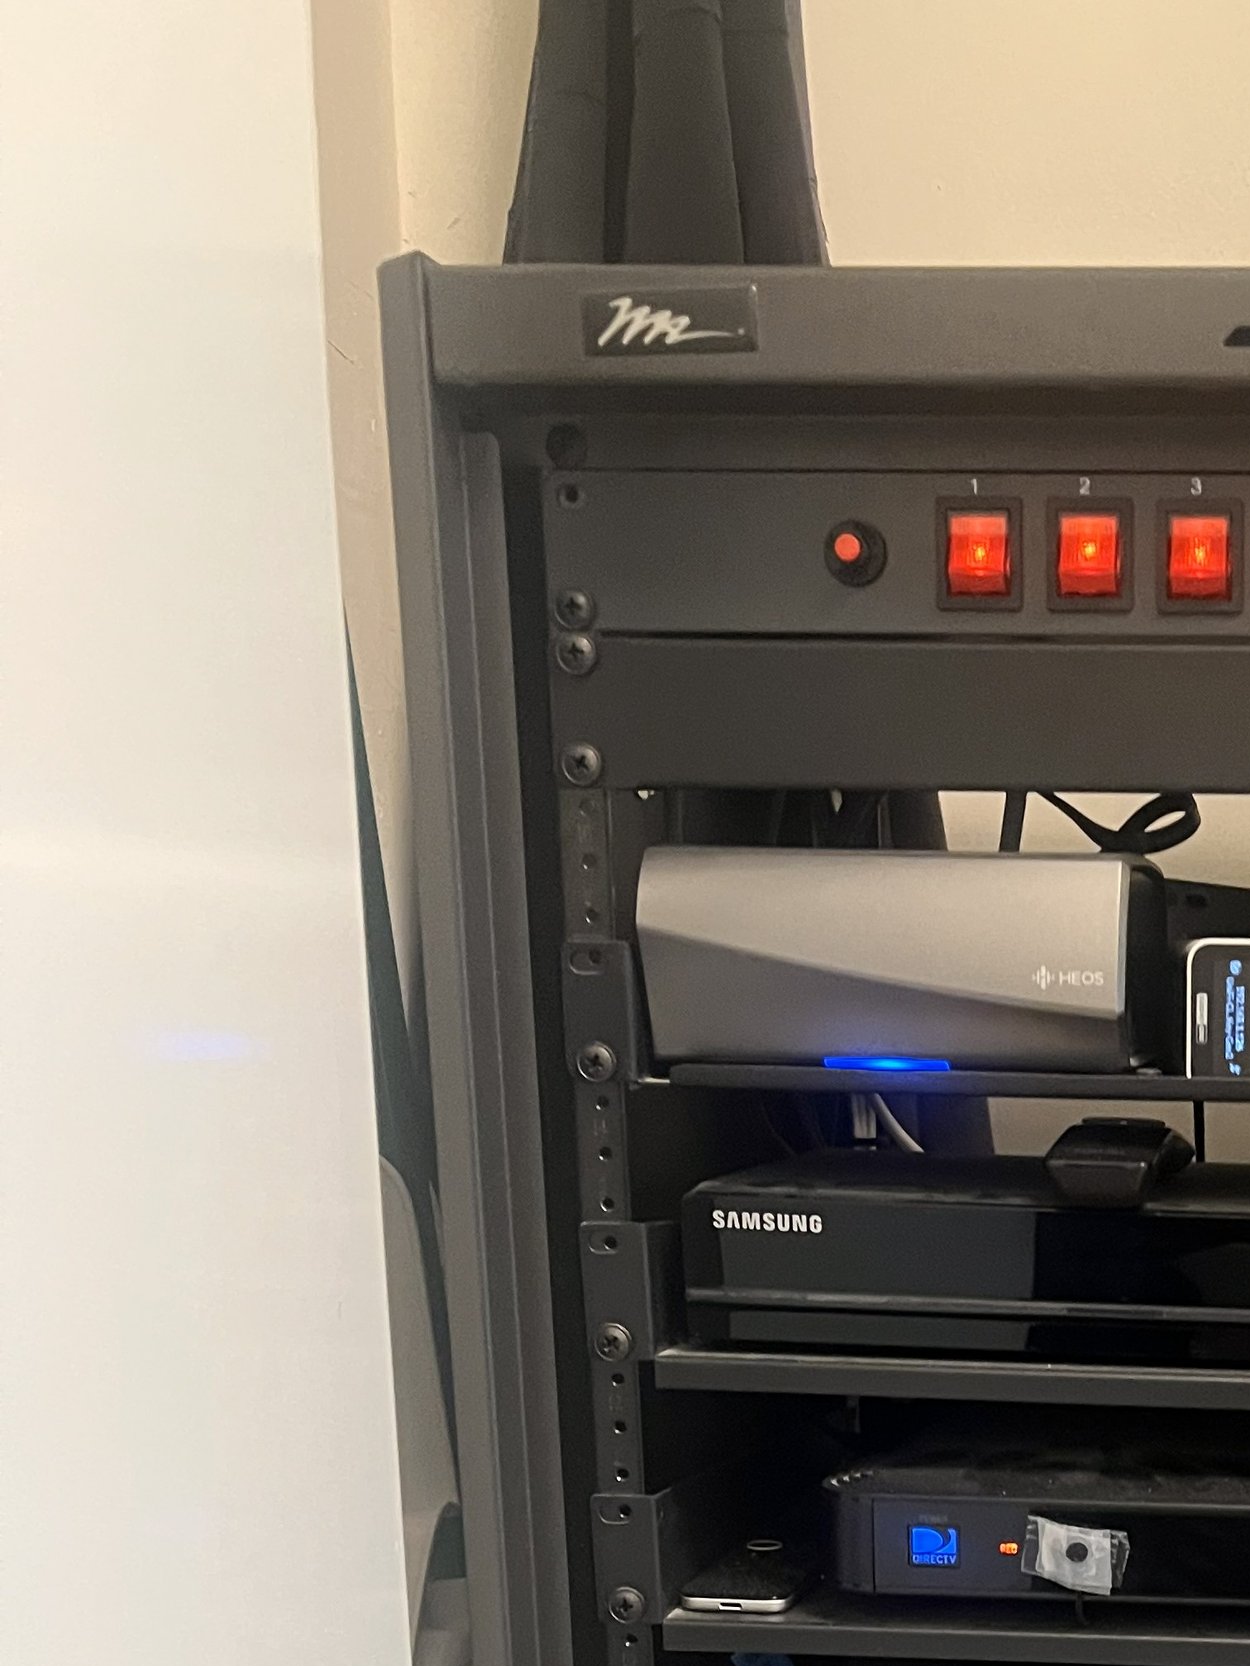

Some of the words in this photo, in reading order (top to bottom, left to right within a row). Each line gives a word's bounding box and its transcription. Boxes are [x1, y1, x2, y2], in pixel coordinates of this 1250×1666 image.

[970, 478, 978, 495] 1
[1079, 477, 1091, 496] 2
[1190, 477, 1202, 496] 3
[1059, 970, 1104, 986] HEOS
[712, 1209, 823, 1234] SAMSUNG
[912, 1554, 957, 1565] DIRECTV
